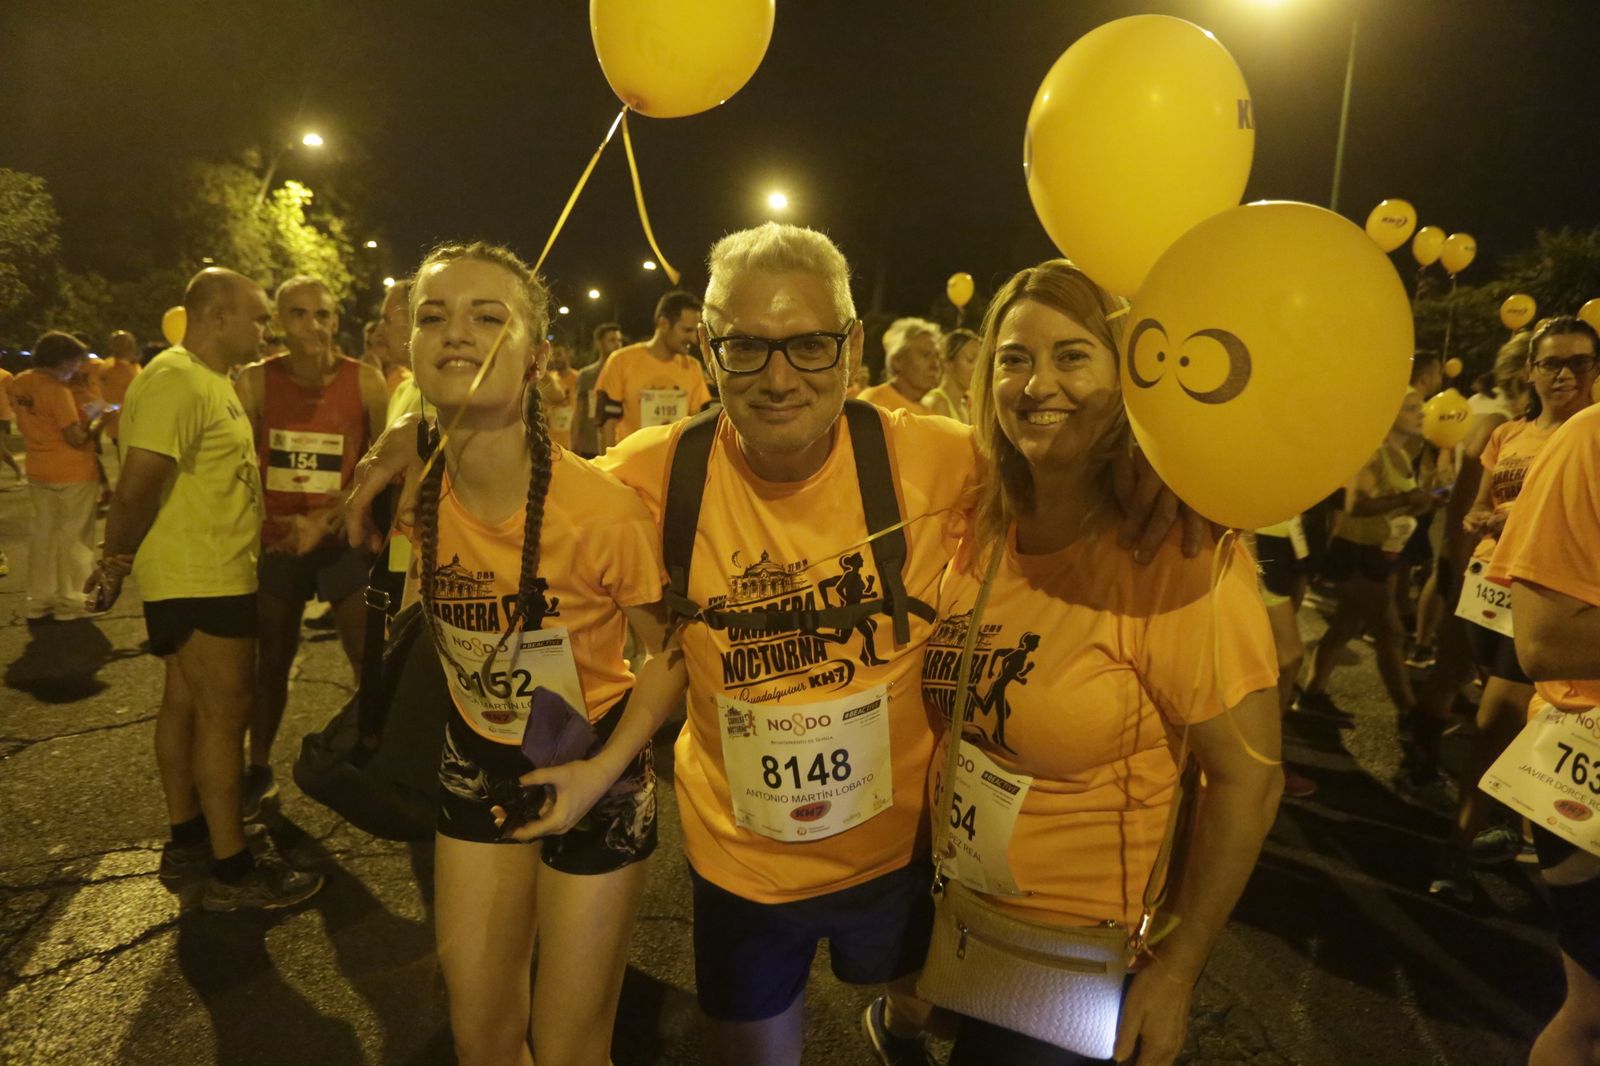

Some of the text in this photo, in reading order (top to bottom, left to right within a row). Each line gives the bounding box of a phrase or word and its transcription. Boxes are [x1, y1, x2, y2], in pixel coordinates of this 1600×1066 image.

[288, 452, 318, 470] 154
[433, 602, 501, 631] RRERA
[720, 637, 827, 684] NOCTURNA
[761, 748, 852, 790] 8148
[1519, 764, 1554, 785] JAVIER
[746, 773, 874, 804] ANTONIO MARTÍN LOBATO
[982, 771, 1019, 795] #BEACTIVE
[963, 844, 982, 863] REAL
